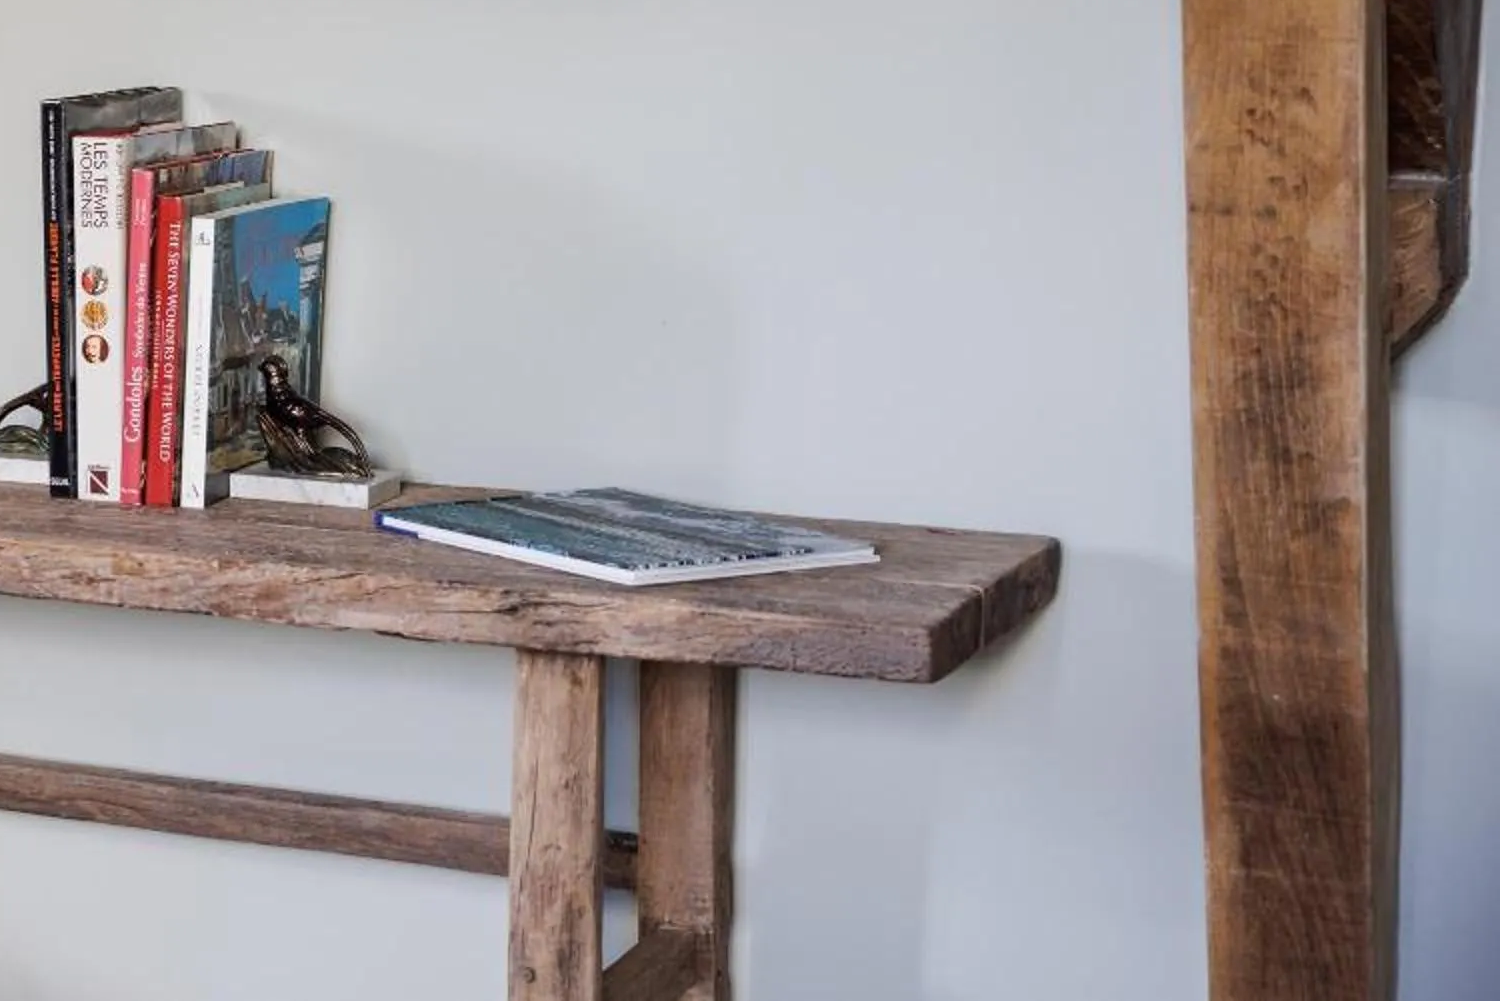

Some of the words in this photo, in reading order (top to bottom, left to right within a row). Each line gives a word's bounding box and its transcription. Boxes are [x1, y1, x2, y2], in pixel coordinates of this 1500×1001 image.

[93, 142, 108, 170] LES
[80, 142, 92, 228] MODERNES
[93, 177, 108, 229] TEMPS
[168, 221, 181, 247] THE
[167, 251, 180, 292] SEVEN
[164, 293, 179, 360] WONDERS
[124, 365, 143, 443] Gondoles
[161, 383, 174, 409] THE
[159, 411, 173, 463] WORLD
